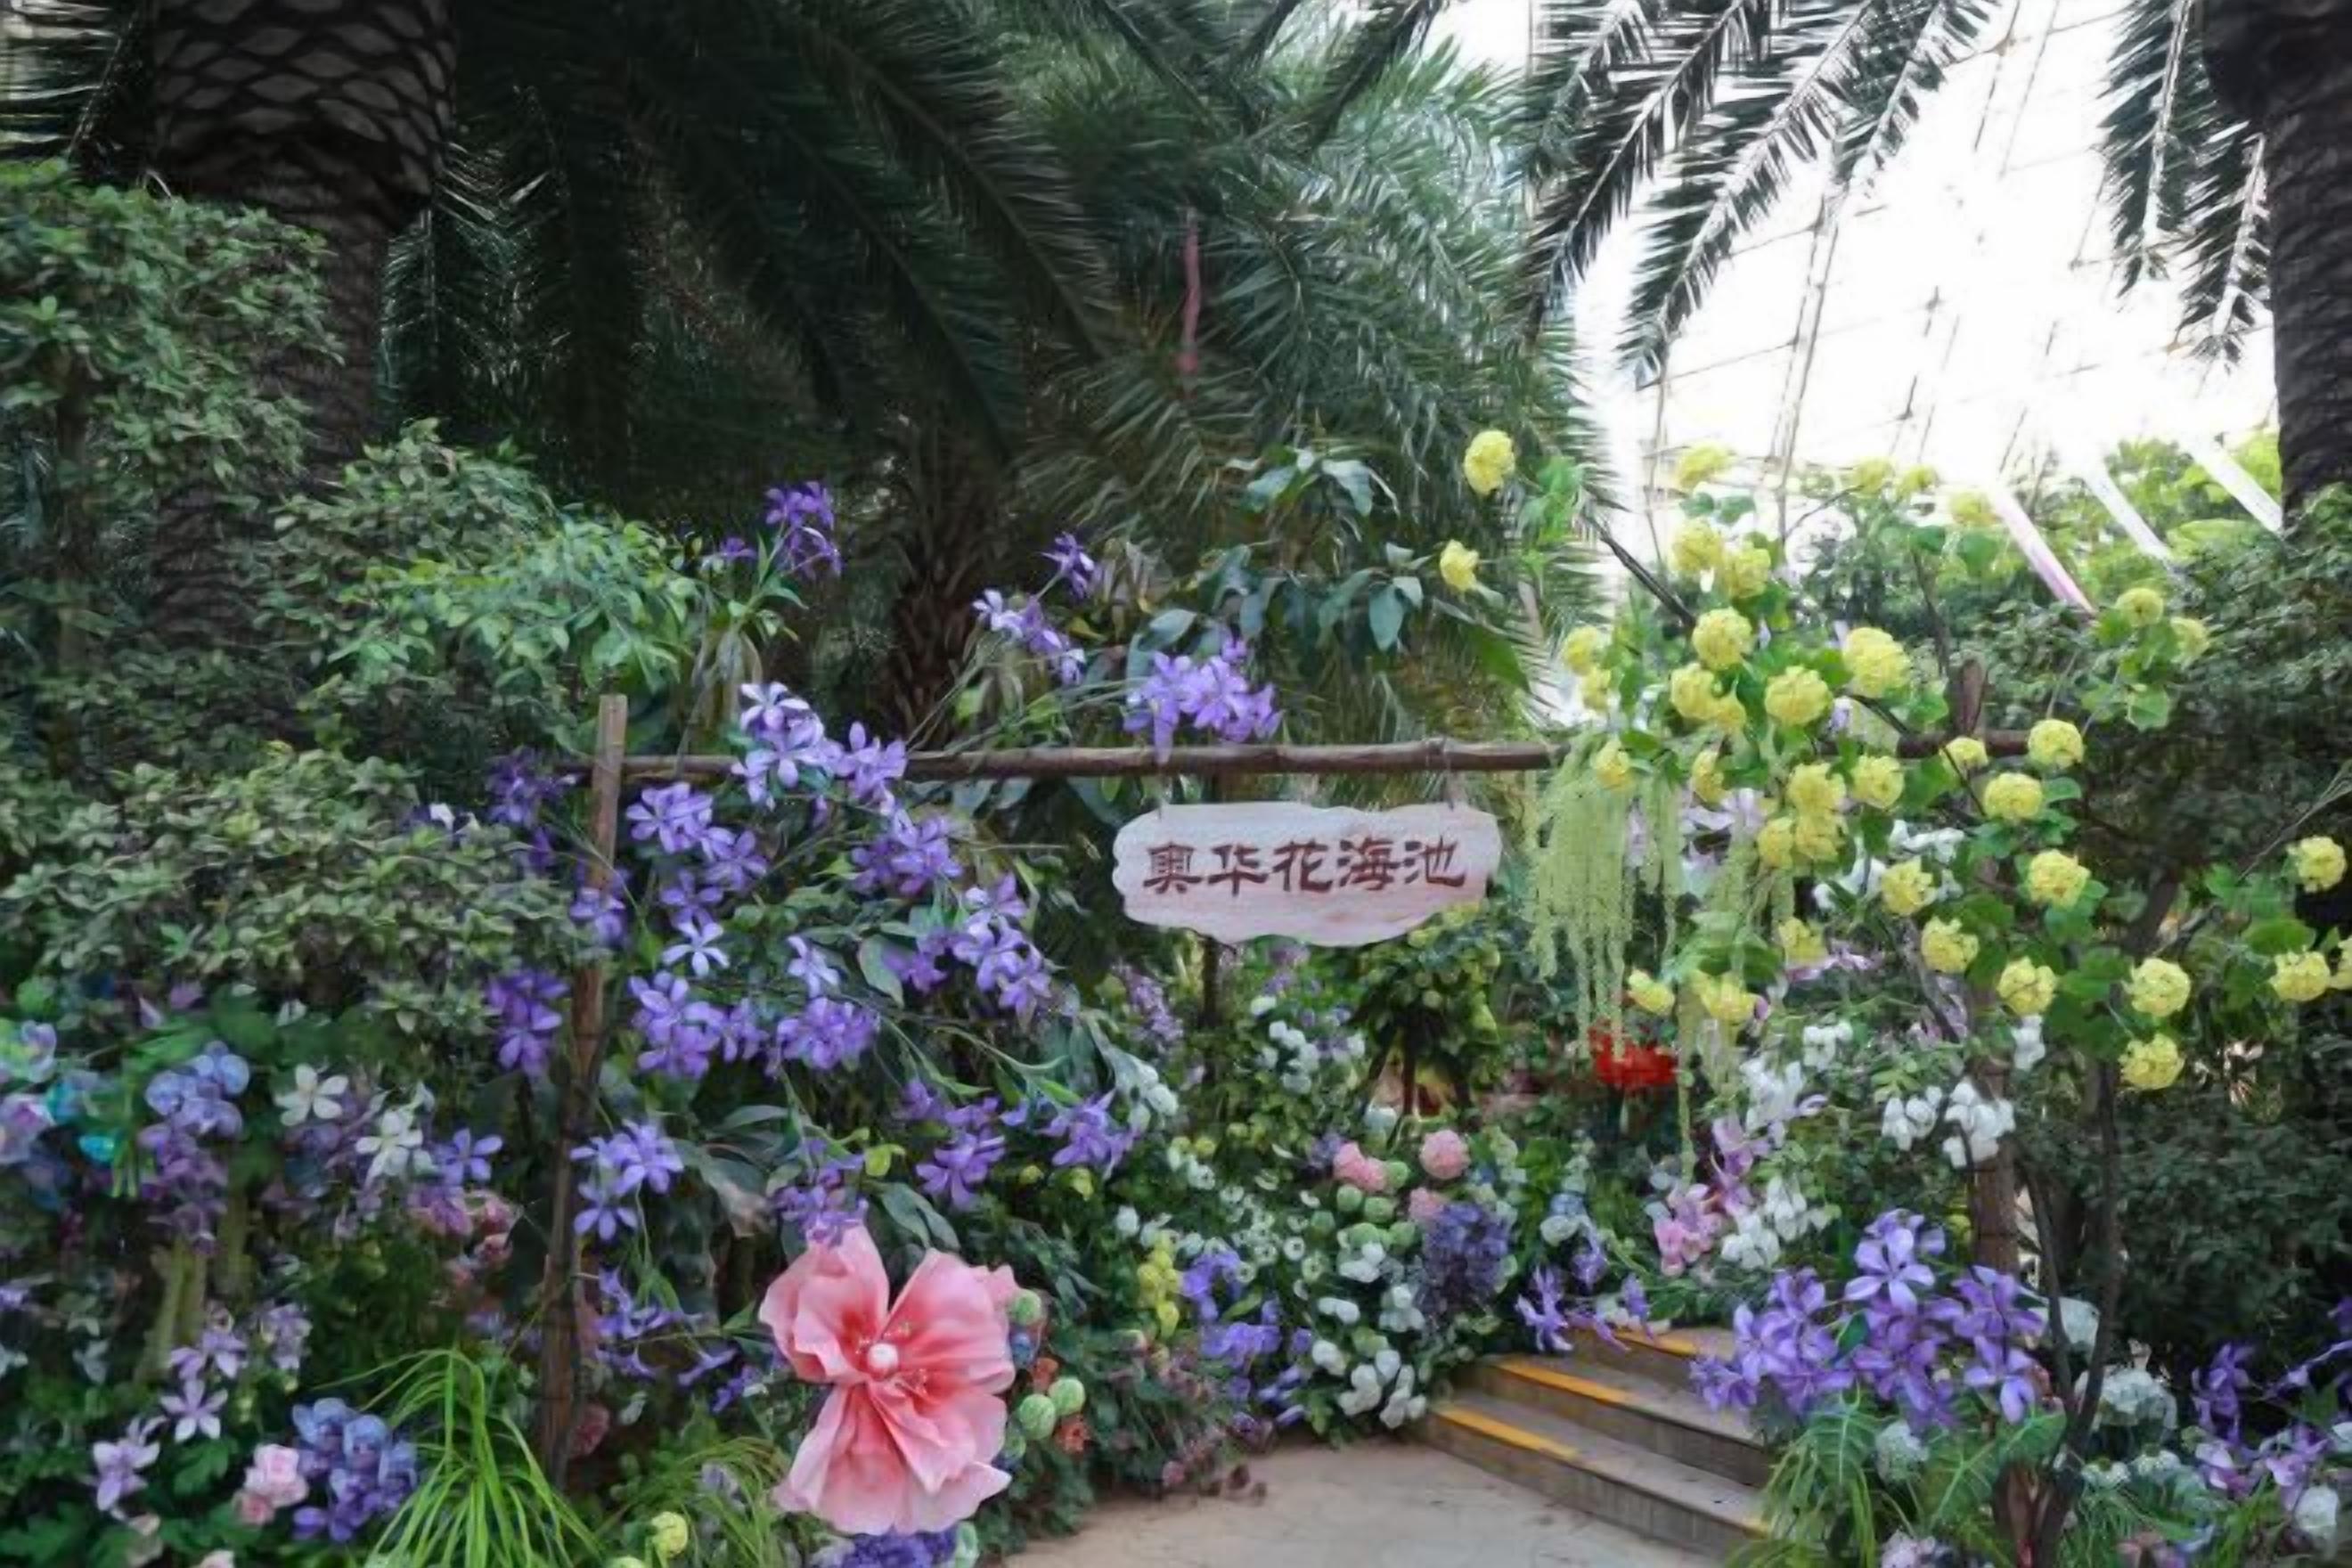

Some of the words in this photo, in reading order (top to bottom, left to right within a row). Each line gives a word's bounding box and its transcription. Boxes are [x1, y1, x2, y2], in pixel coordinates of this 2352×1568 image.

[1143, 836, 1466, 897] 奥华花海池
